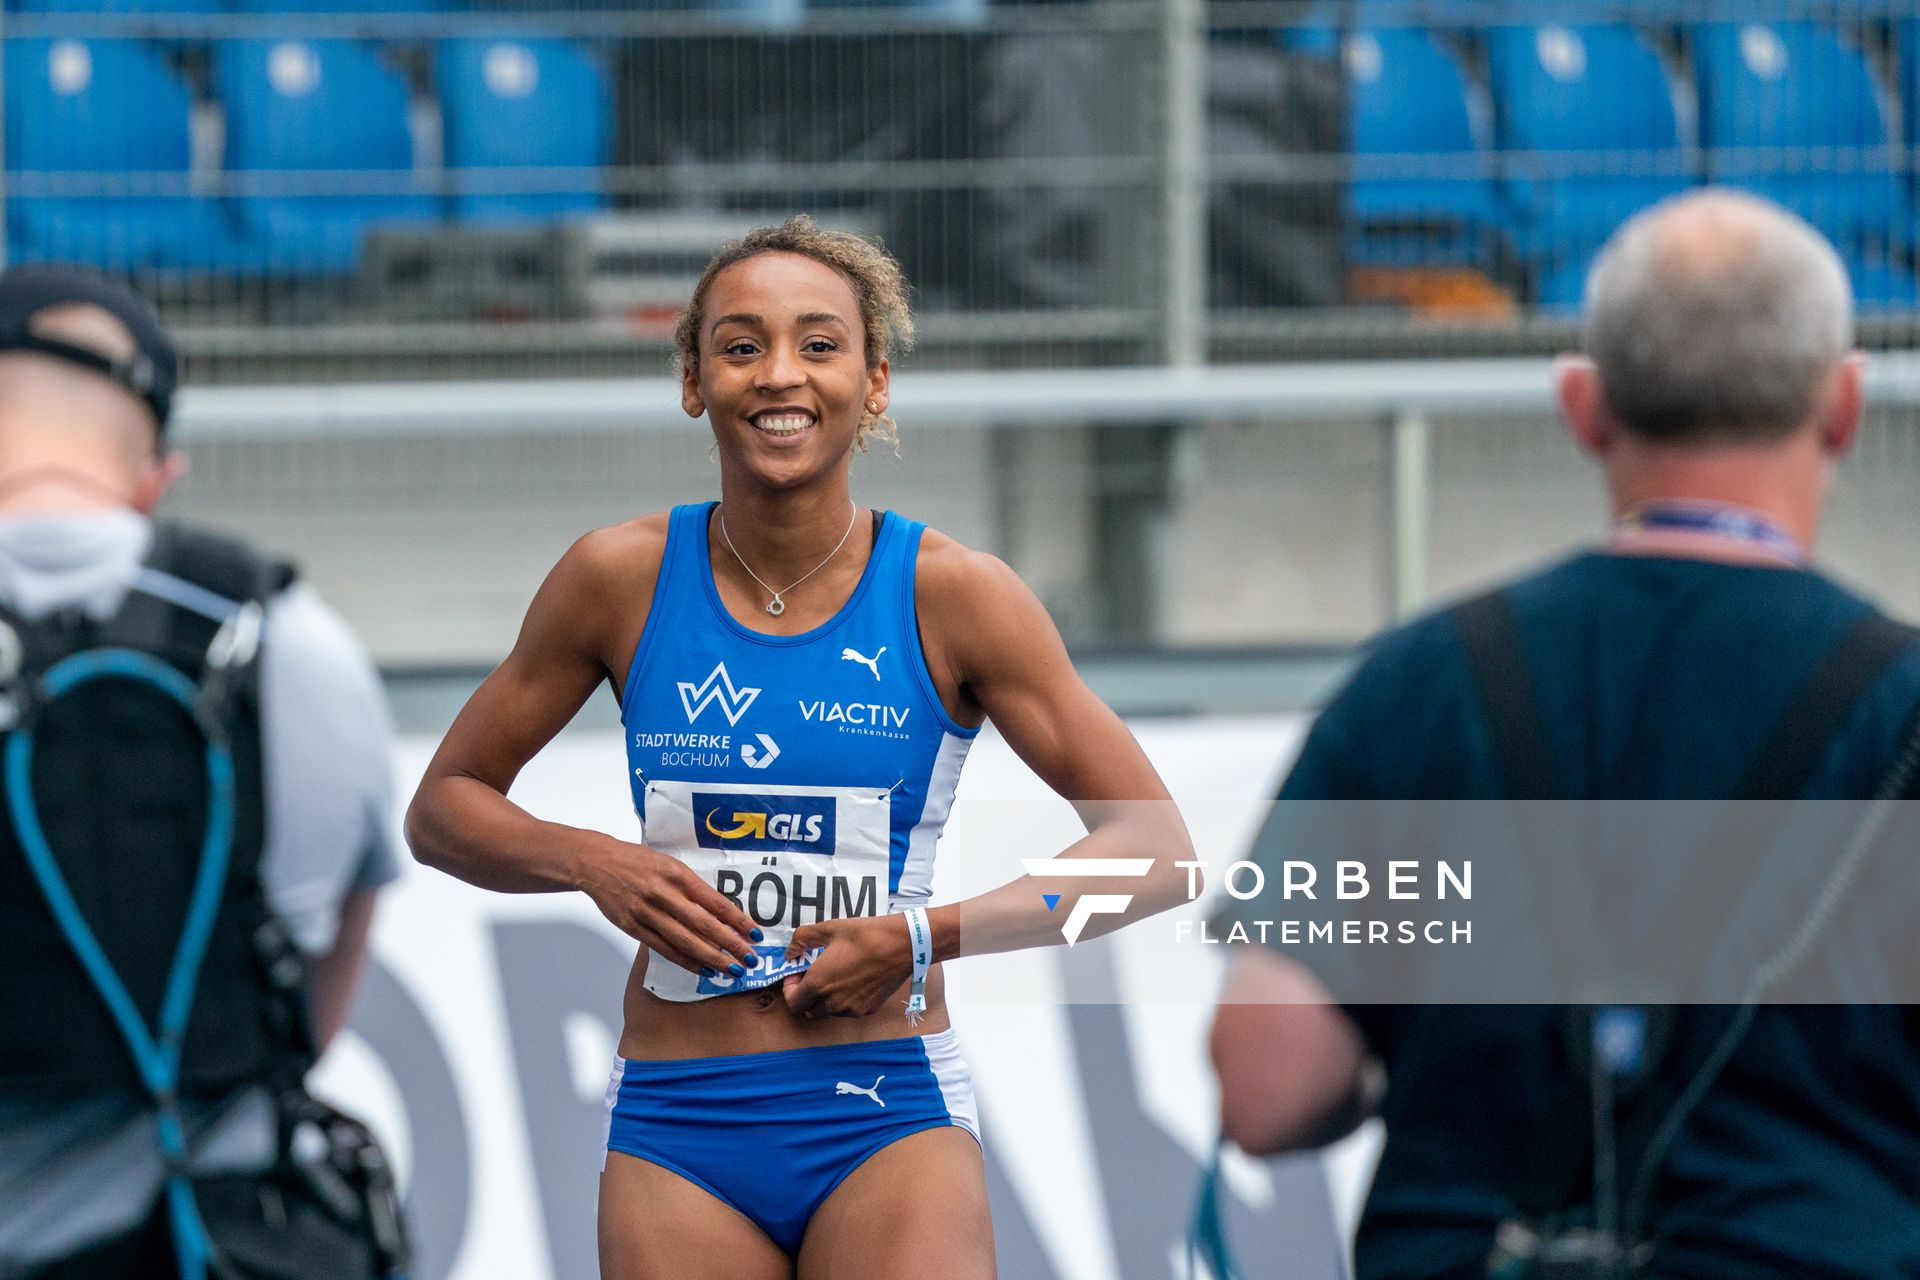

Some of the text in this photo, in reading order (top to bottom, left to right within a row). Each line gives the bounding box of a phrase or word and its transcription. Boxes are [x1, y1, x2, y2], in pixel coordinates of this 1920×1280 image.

[798, 700, 910, 728] VIACTIV
[635, 733, 731, 749] STADTWERKE
[839, 725, 910, 740] Krankenkasse
[661, 752, 730, 767] BOCHUM
[767, 813, 823, 842] GLS
[717, 856, 877, 928] BÖHM
[746, 947, 819, 977] PLAN
